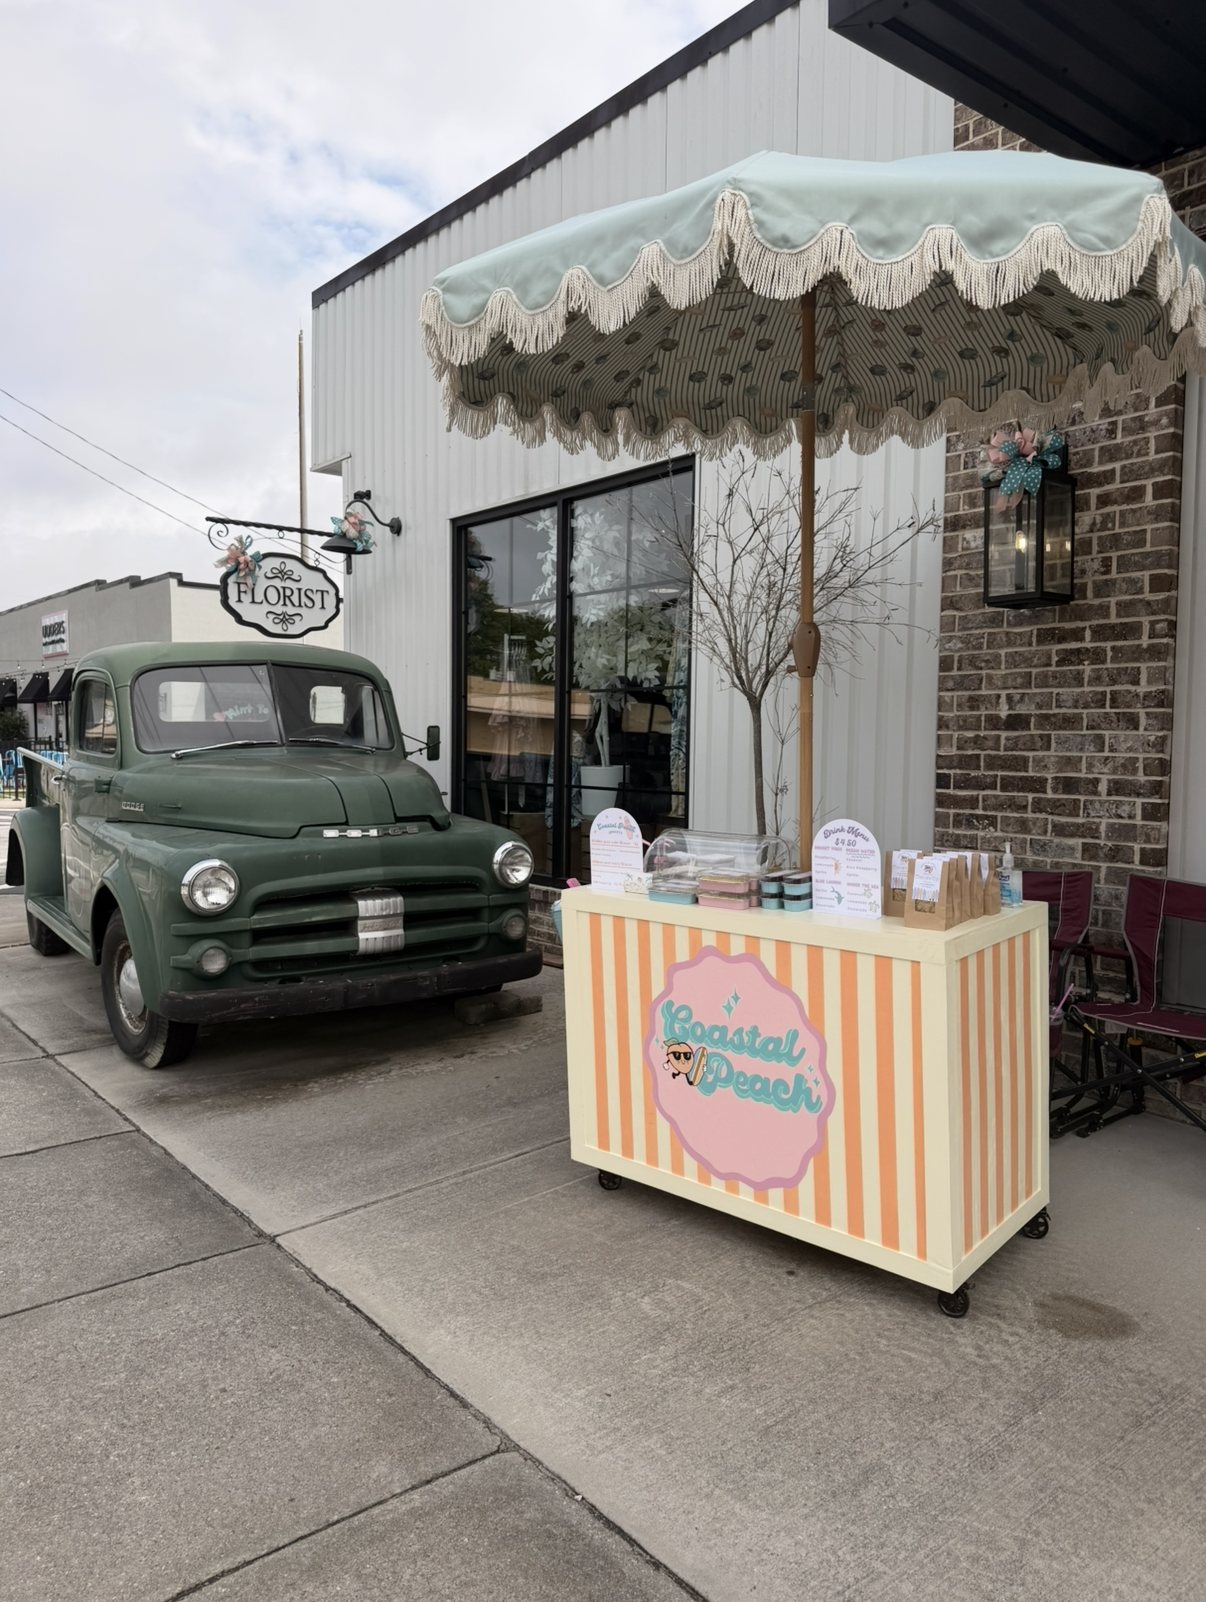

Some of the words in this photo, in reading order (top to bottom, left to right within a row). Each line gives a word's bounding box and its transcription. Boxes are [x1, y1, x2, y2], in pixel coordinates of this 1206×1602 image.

[233, 581, 330, 610] FLORIST
[323, 825, 419, 838] DODGE
[823, 826, 846, 839] Drink
[846, 826, 870, 842] Menu
[835, 838, 857, 847] $4.50
[660, 1000, 806, 1068] Coastal
[696, 1052, 823, 1114] Peach
